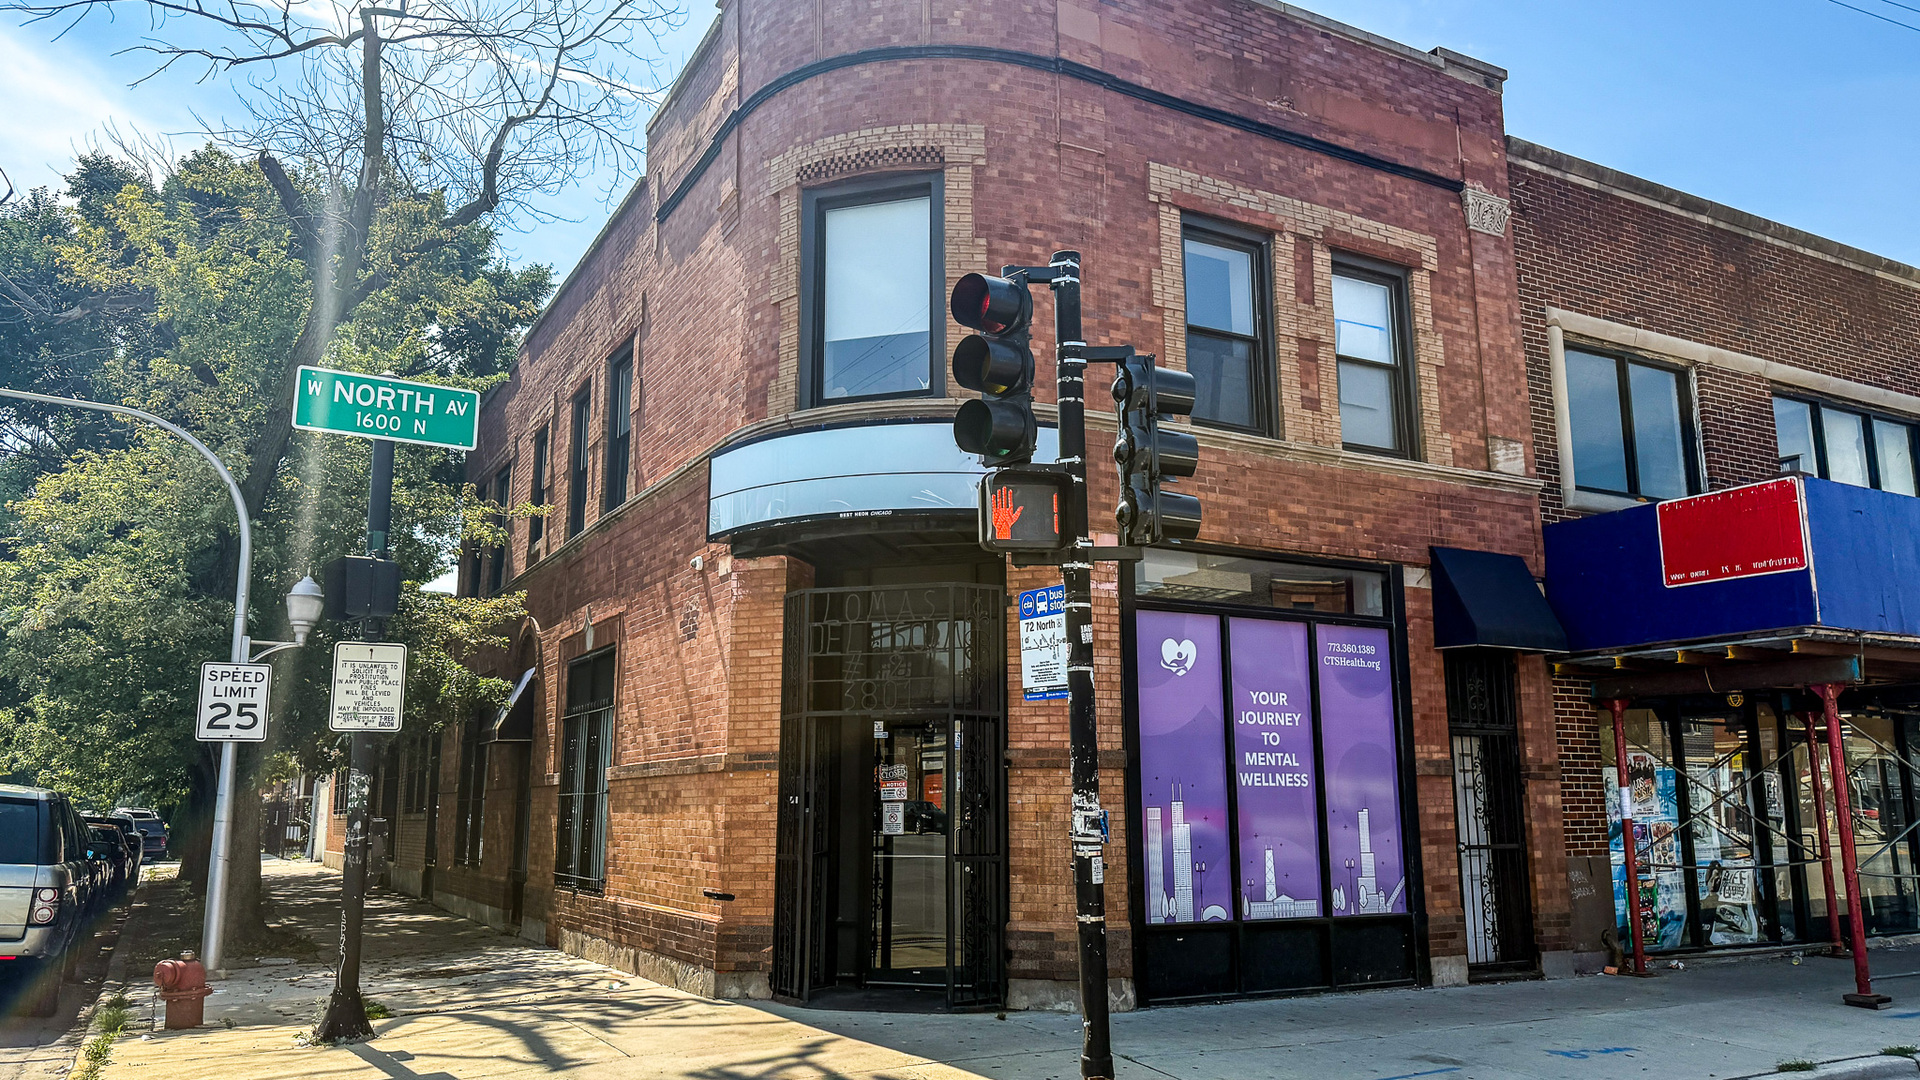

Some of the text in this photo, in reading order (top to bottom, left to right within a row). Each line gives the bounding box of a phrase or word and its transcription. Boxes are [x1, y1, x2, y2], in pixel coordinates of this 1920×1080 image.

[307, 379, 469, 417] W NORTH AV
[355, 411, 427, 435] 1600 N
[1048, 590, 1063, 600] bus
[823, 589, 936, 624] LOMAS
[1050, 600, 1066, 612] stop
[1024, 619, 1056, 633] 72 North
[1327, 642, 1376, 655] 773.360.1389
[1323, 656, 1381, 671] CTSHealth.org
[208, 670, 266, 683] SPEED
[213, 686, 258, 698] LIMIT
[844, 679, 911, 712] 3801
[1250, 690, 1288, 706] YOUR
[206, 702, 259, 730] 25
[1238, 710, 1302, 726] JOURNEY
[1261, 732, 1280, 746] TO
[1245, 752, 1300, 767] MENTAL
[881, 768, 906, 779] CLOSED
[1239, 772, 1309, 788] WELLNESS
